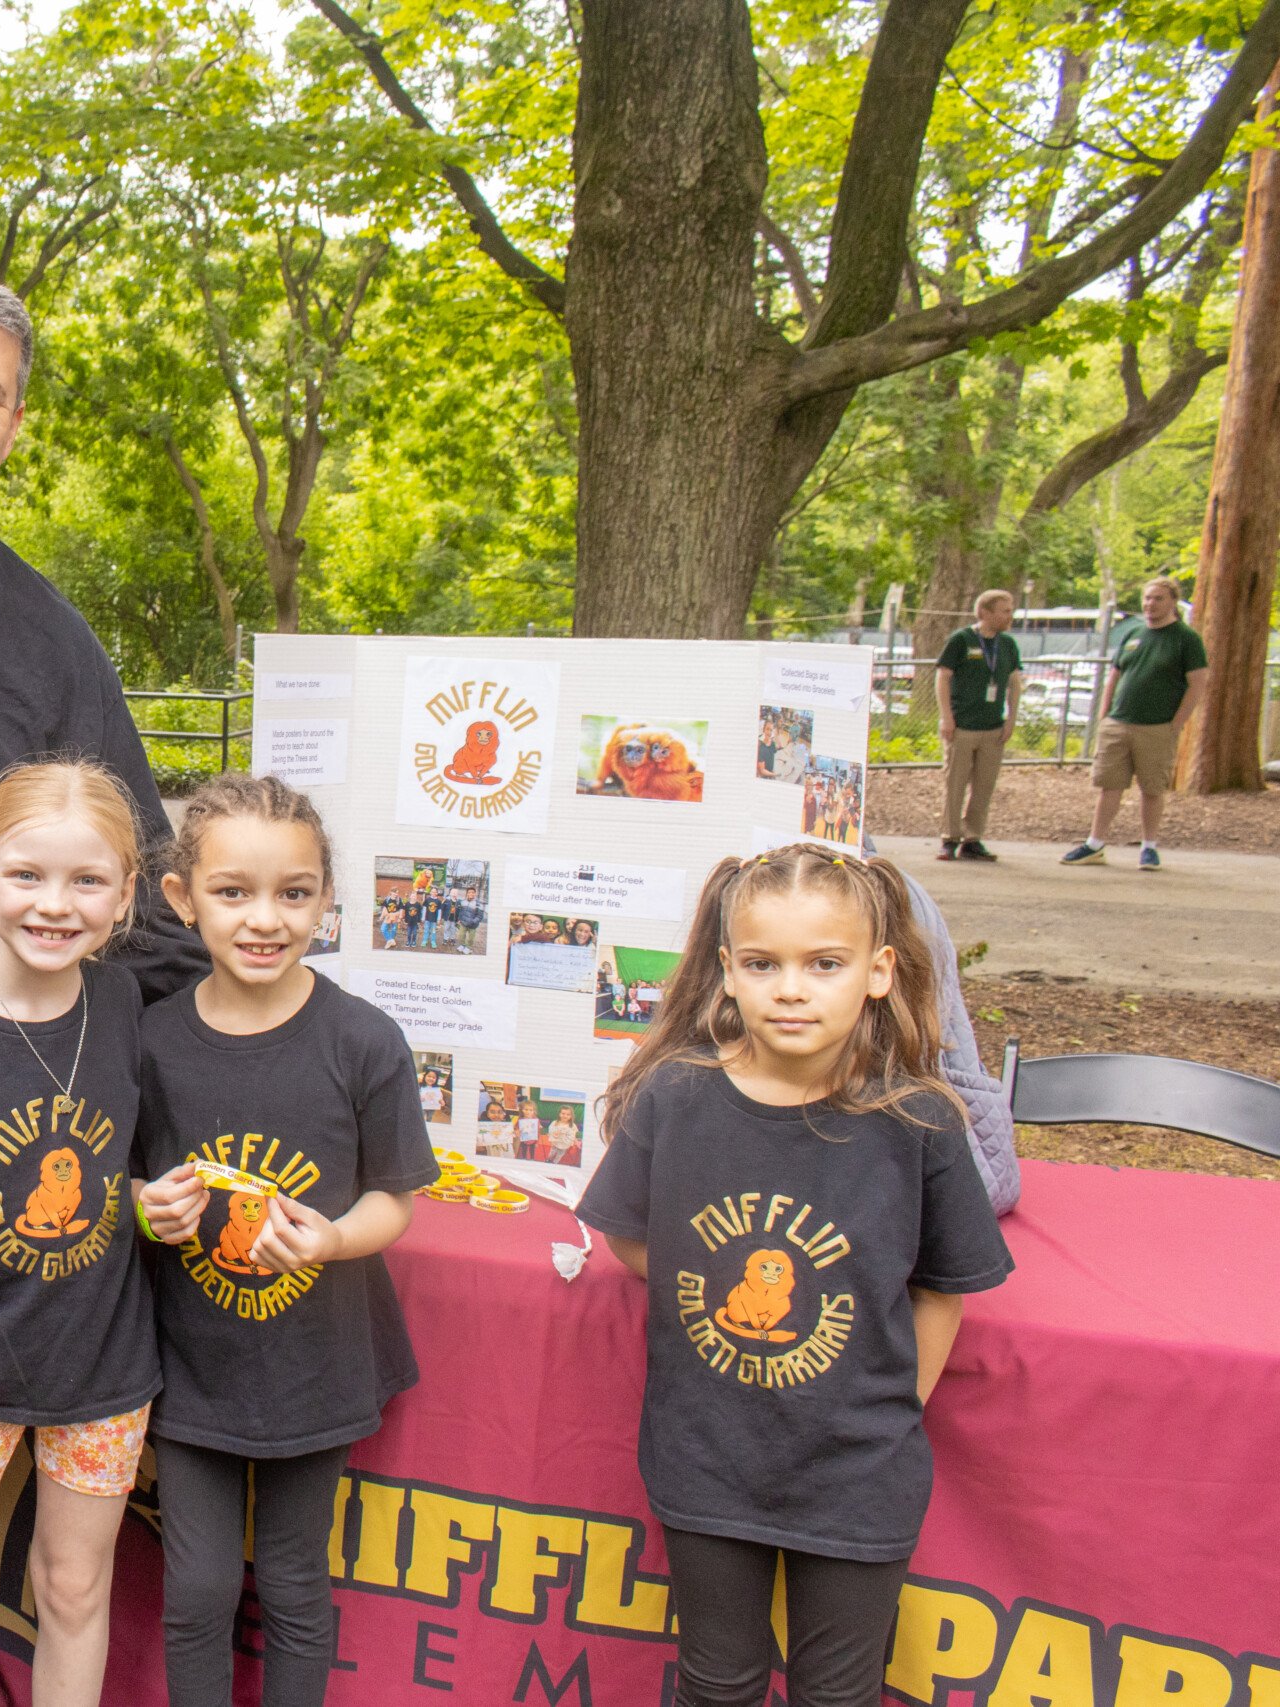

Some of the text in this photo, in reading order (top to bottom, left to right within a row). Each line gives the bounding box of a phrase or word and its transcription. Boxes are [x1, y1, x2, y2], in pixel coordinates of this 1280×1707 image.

[425, 681, 539, 732] MIFFLIN
[415, 743, 459, 812] GOLDEN
[460, 750, 541, 819] GUARDIANS
[533, 867, 570, 879] Donated
[596, 873, 615, 884] Red
[617, 874, 644, 886] Creek
[532, 880, 628, 897] Wildlife Center to help
[531, 893, 623, 909] rebuild after their fire.
[375, 978, 408, 989] Created
[410, 981, 442, 992] Ecofest
[449, 985, 461, 994] Art
[374, 990, 472, 1007] Contest for best Golden
[393, 1004, 427, 1014] Tamarin
[414, 1018, 440, 1028] poster
[442, 1021, 456, 1030] per
[458, 1022, 483, 1032] grade
[227, 1169, 271, 1193] Guardians
[690, 1192, 851, 1270] MIFFLIN
[677, 1270, 737, 1374] GOLDEN
[738, 1294, 854, 1389] GUARDIANS
